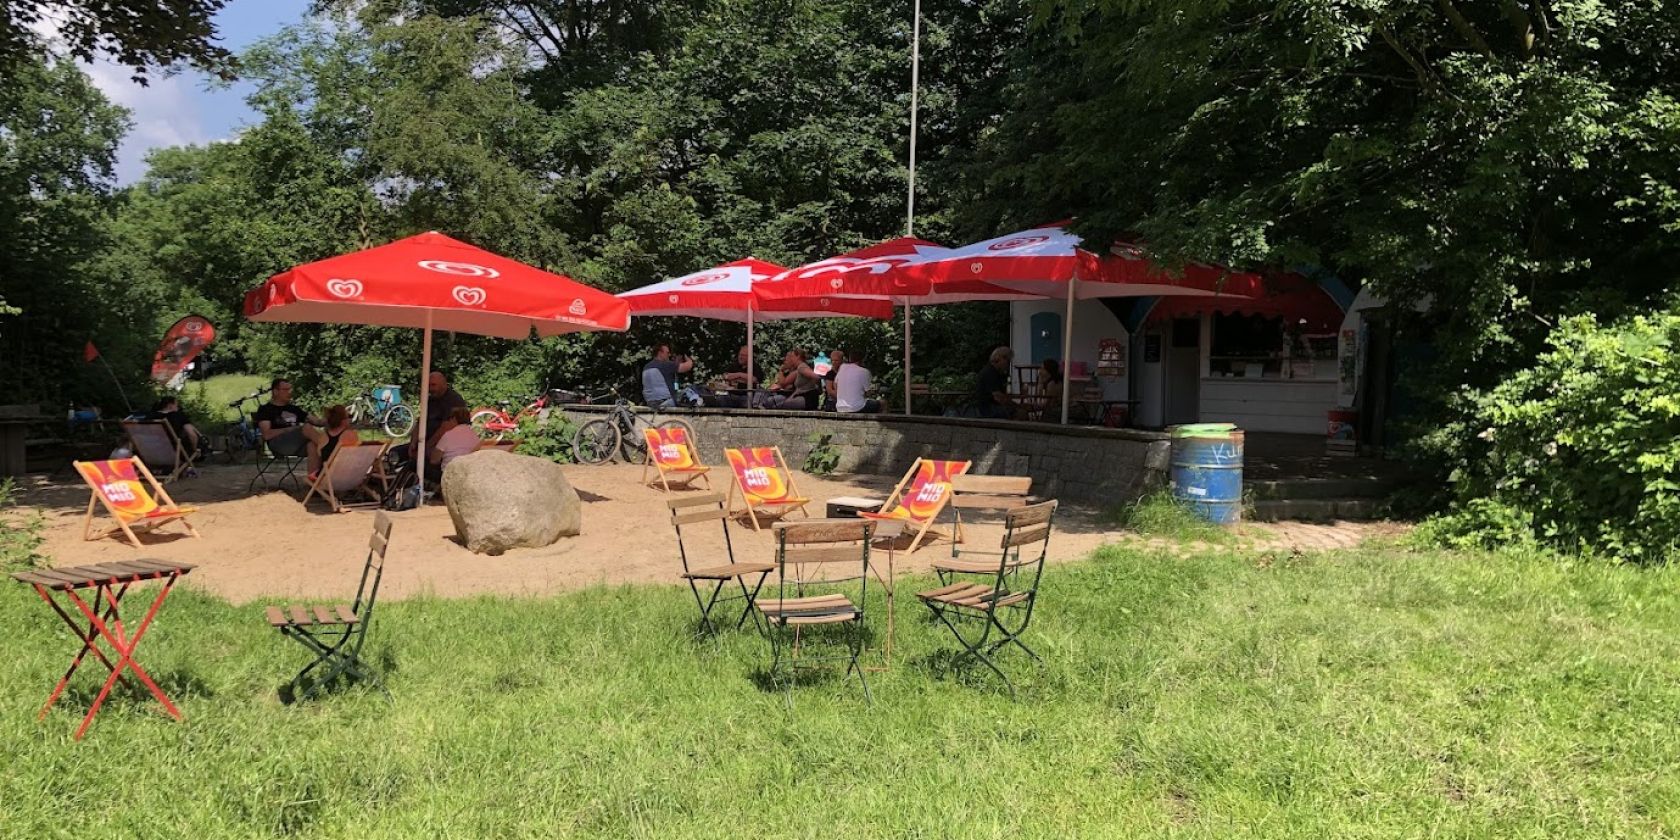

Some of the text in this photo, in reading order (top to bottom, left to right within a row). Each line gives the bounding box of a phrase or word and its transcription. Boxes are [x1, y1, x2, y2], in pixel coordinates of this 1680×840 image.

[659, 444, 678, 452] MIO
[744, 468, 766, 479] MIO
[747, 477, 770, 487] MIO
[102, 483, 130, 494] MIO
[920, 482, 946, 494] MIO
[107, 492, 136, 502] MIO
[916, 492, 941, 502] MIO
